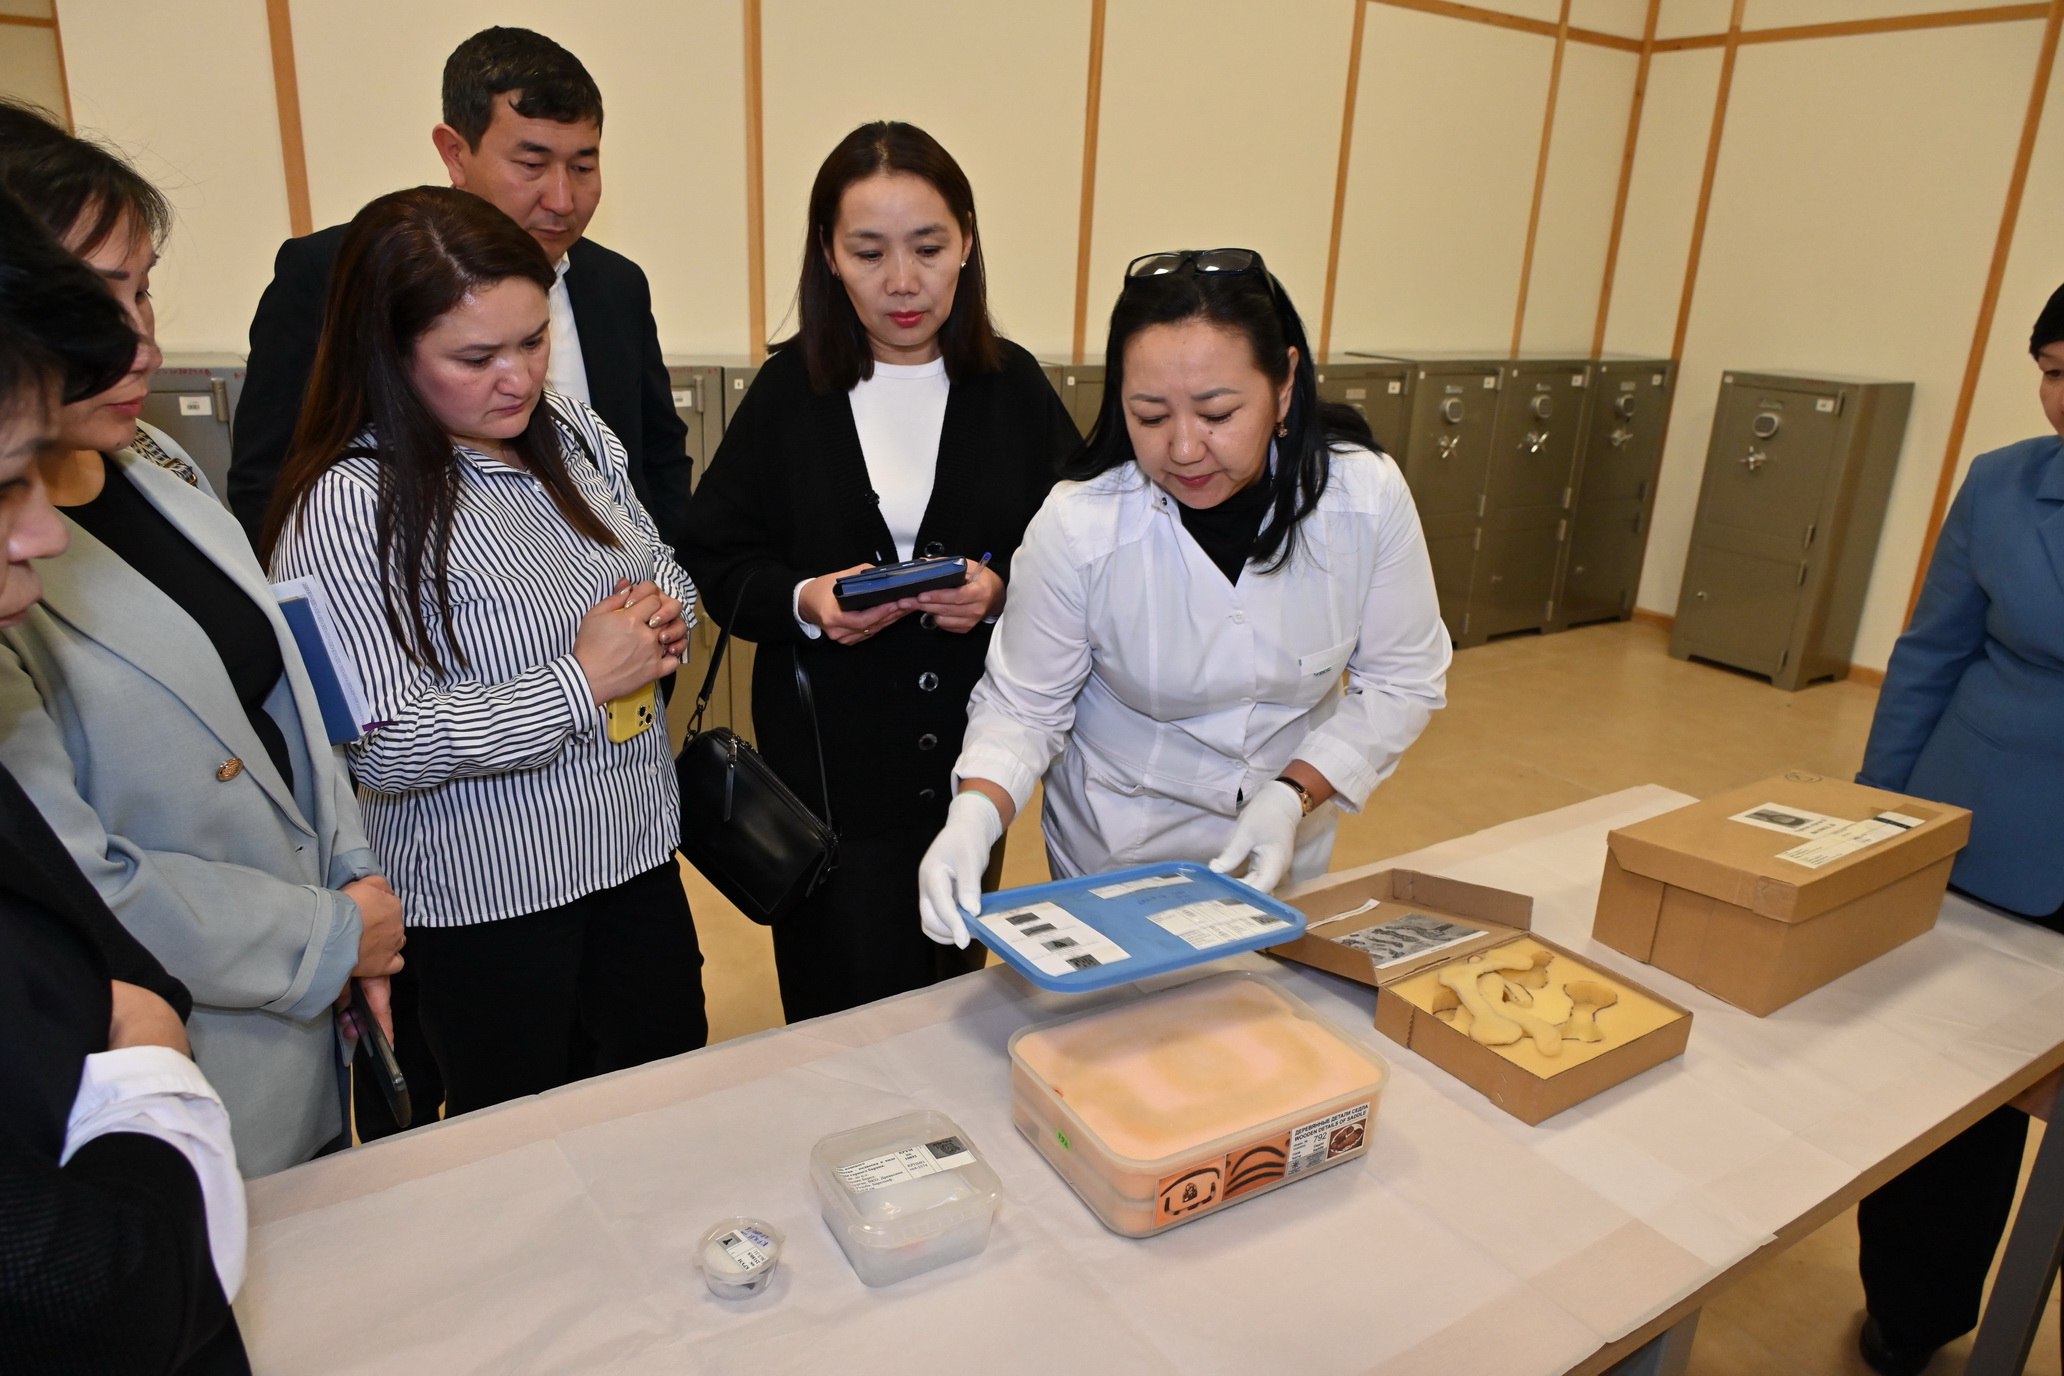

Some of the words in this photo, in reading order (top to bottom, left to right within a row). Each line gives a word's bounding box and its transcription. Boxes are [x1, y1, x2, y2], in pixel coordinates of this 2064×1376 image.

[1294, 1118, 1330, 1136] ДЕРЕВЯННЫЕ
[1331, 1110, 1351, 1123] ДЕТАЛИ
[1351, 1104, 1368, 1114] СЕДЛА
[1294, 1129, 1317, 1142] WOODEN
[1318, 1121, 1338, 1133] DETAILS
[1347, 1110, 1366, 1121] SADDLE
[1313, 1132, 1327, 1143] 792
